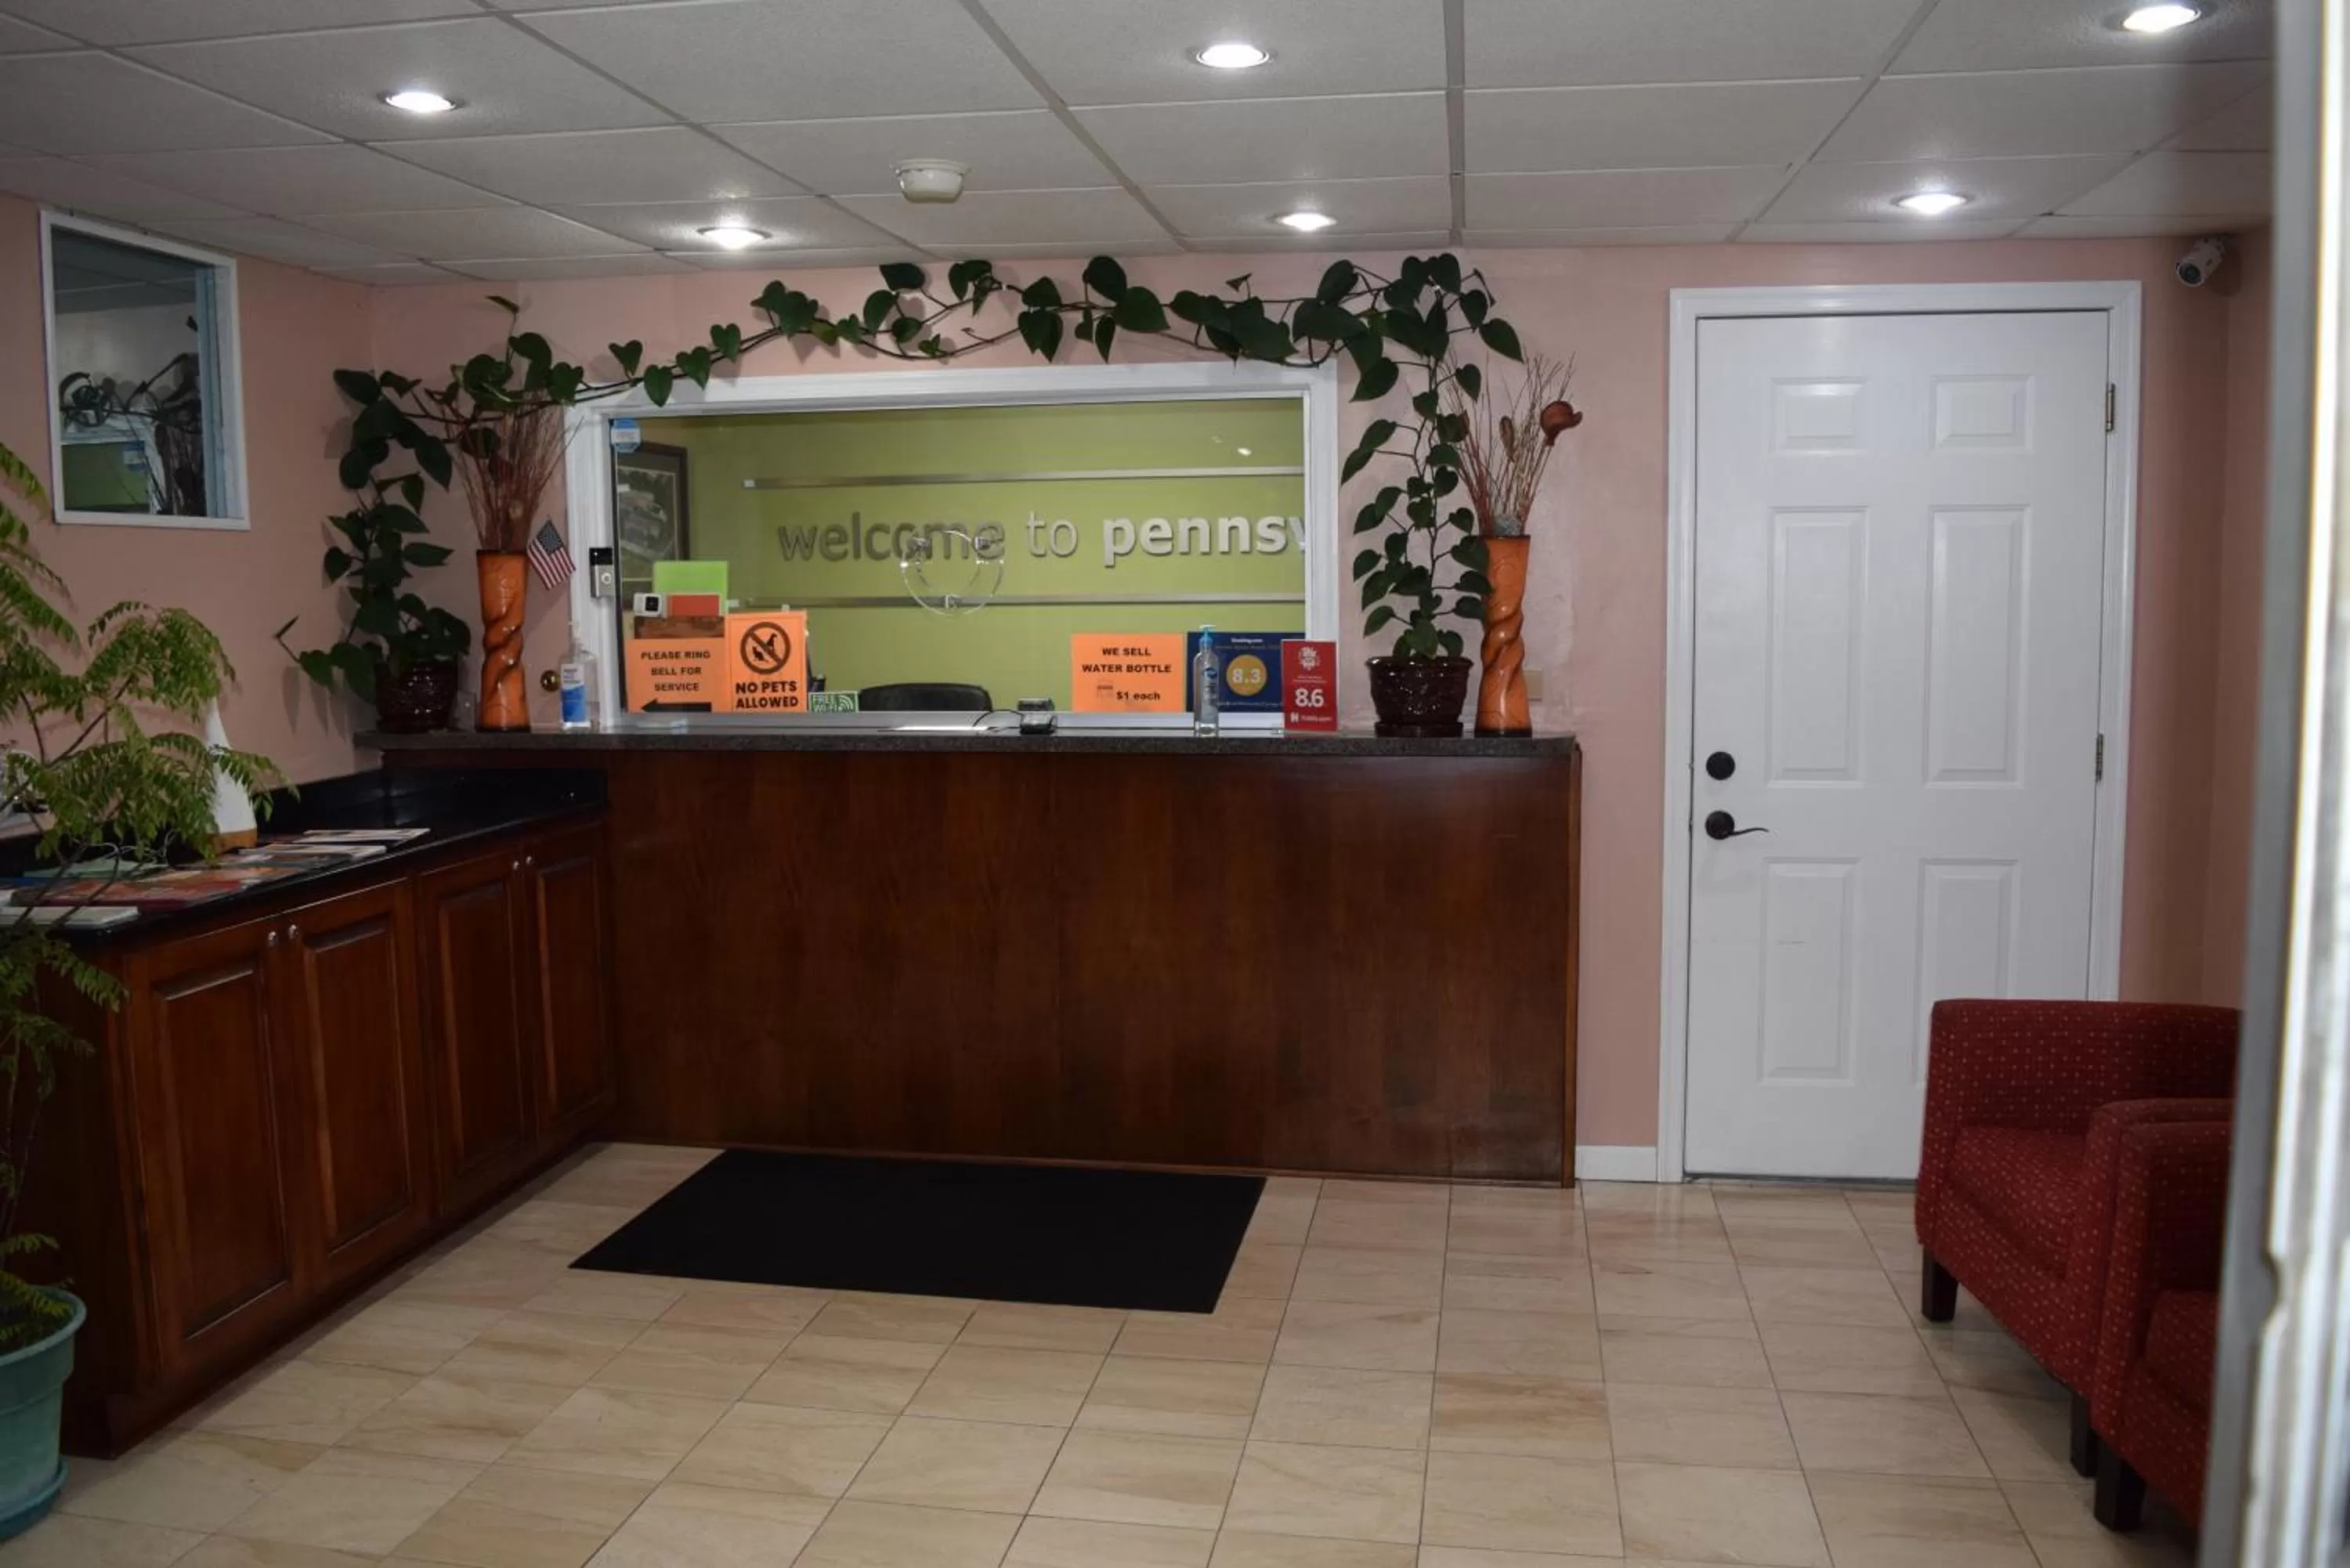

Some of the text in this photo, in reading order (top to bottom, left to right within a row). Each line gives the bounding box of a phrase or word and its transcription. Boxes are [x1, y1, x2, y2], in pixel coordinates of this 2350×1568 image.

[777, 511, 1005, 562] welcome
[1026, 511, 1078, 558] to
[641, 651, 710, 660] PLEASE RING
[1102, 648, 1152, 656] WE SELL
[651, 667, 702, 676] BELL FOR
[1082, 663, 1173, 673] WATER BOTTLE
[1231, 667, 1261, 684] 8.3
[654, 682, 700, 692] SERVICE
[736, 681, 797, 694] NO PETS
[1116, 691, 1161, 700] $1 each
[1295, 688, 1324, 707] 8.6
[736, 696, 799, 709] ALLOWED
